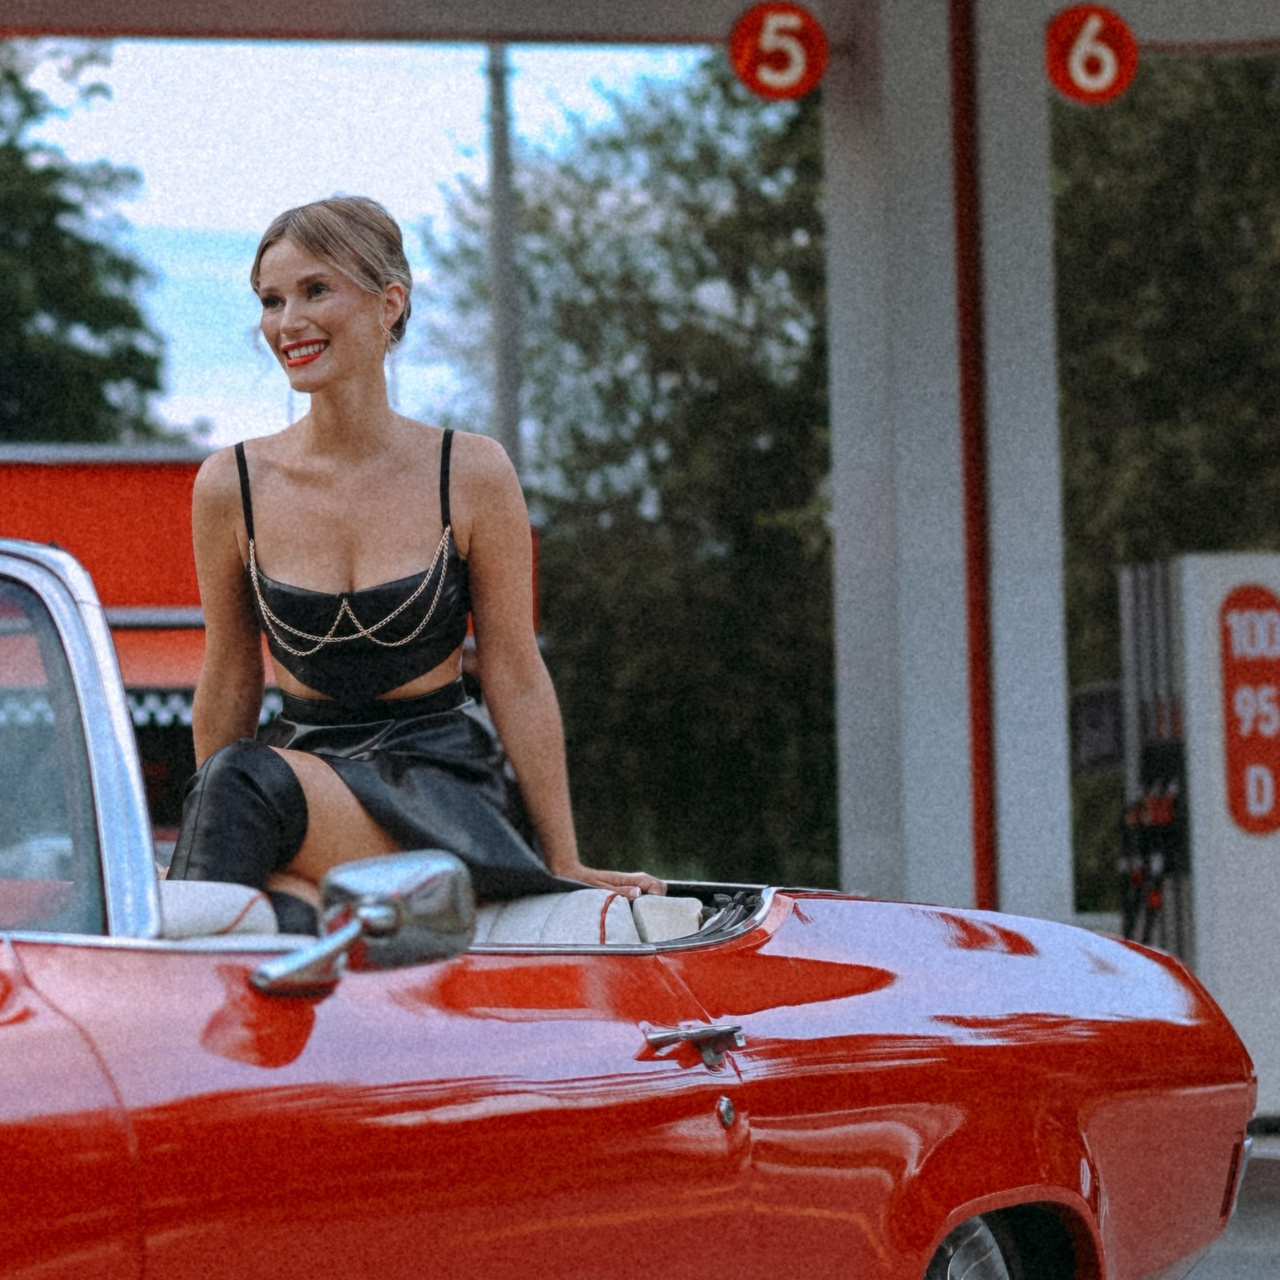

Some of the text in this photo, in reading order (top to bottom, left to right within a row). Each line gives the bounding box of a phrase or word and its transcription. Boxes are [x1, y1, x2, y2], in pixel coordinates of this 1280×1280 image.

[756, 12, 807, 89] 5
[1067, 14, 1119, 92] 6
[1233, 684, 1280, 738] 95
[1245, 763, 1275, 817] D
